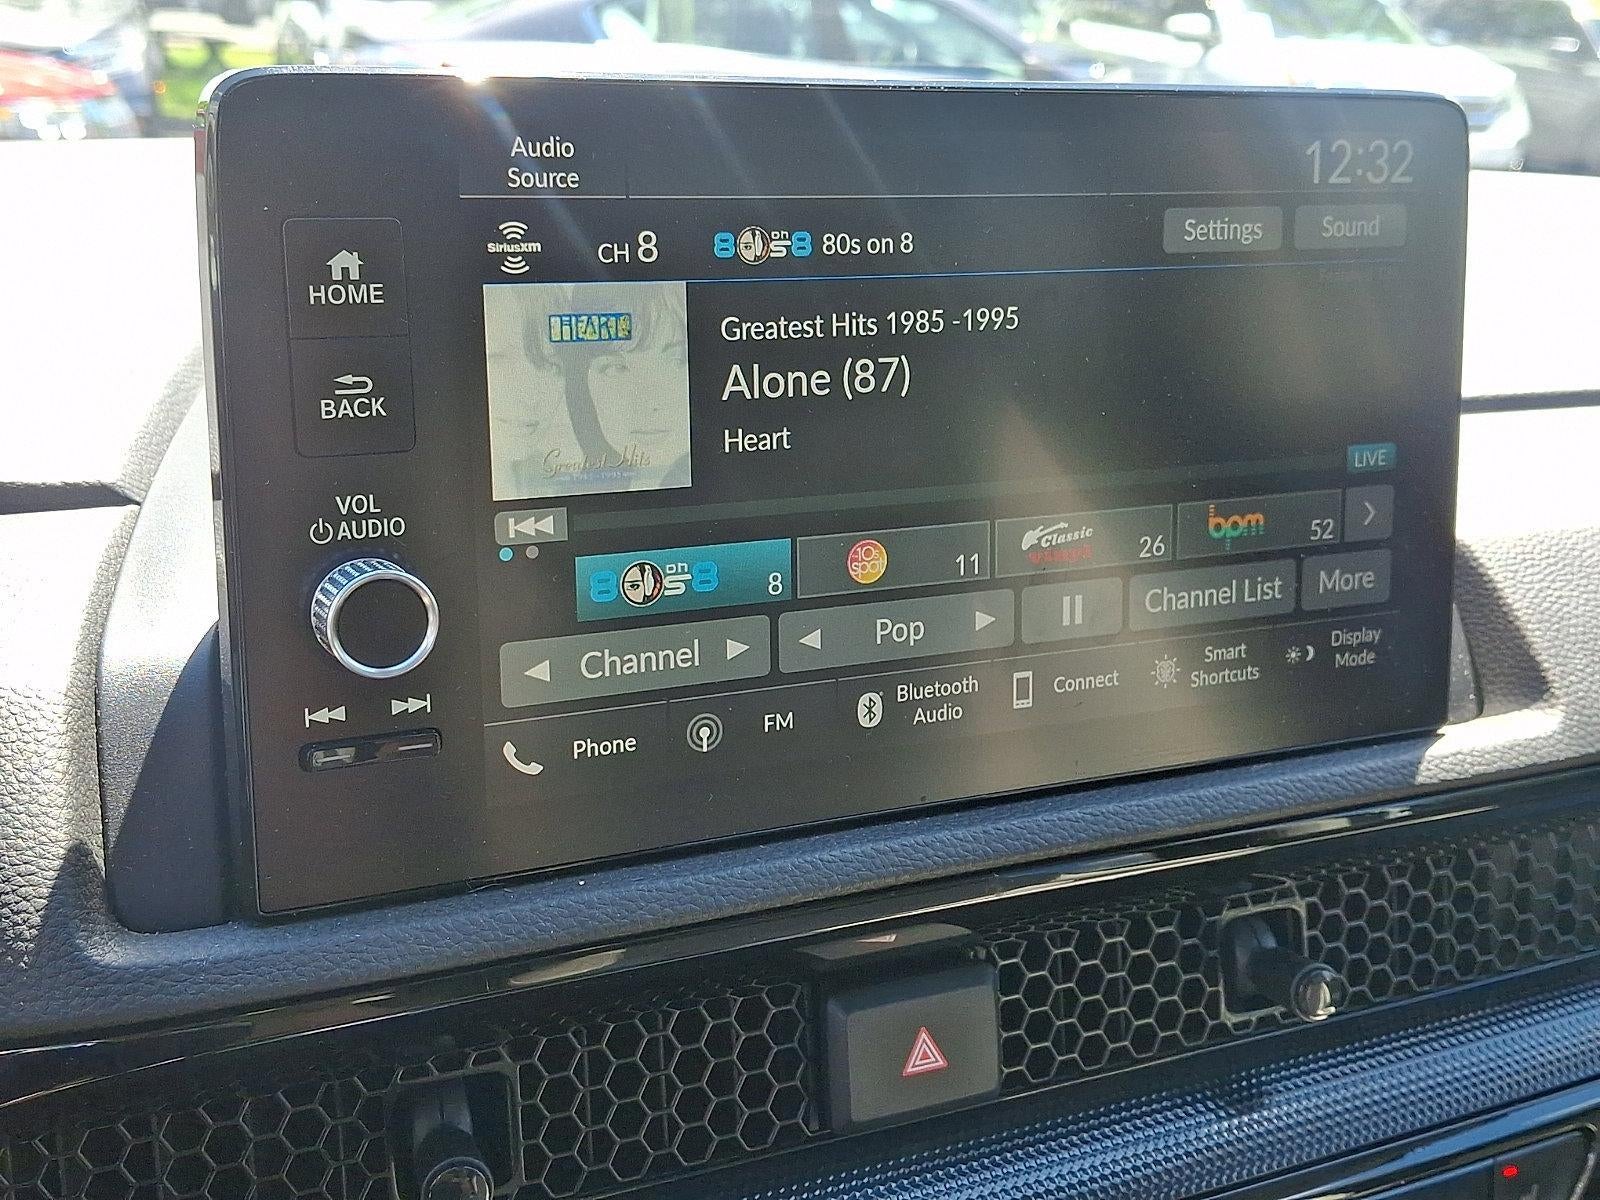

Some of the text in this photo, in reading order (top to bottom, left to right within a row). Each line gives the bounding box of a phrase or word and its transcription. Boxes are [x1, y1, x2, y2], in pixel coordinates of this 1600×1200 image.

[510, 136, 575, 159] Audio
[1306, 139, 1414, 185] 12:32
[507, 167, 580, 190] Source
[1184, 217, 1263, 244] Settings
[1321, 215, 1381, 238] Sound
[598, 230, 659, 264] CH 8
[822, 232, 914, 256] 80s on 8
[308, 284, 385, 306] HOME
[720, 306, 1020, 342] Greatest Hits 1985 -1995
[721, 355, 911, 401] Alone (87)
[320, 397, 387, 420] BACK
[724, 426, 791, 453] Heart
[1354, 449, 1387, 468] LIVE
[335, 495, 381, 515] VOL
[337, 517, 406, 541] AUDIO
[1041, 526, 1094, 548] Classic
[1310, 518, 1335, 541] 52
[1139, 535, 1166, 559] 26
[955, 553, 981, 577] 11
[768, 572, 784, 596] 8
[1318, 569, 1375, 595] More
[1145, 575, 1283, 614] Channel List
[875, 618, 926, 647] Pop
[1330, 626, 1382, 650] Display
[580, 639, 700, 679] Channel
[1204, 642, 1248, 662] Smart
[1334, 648, 1376, 669] Mode
[1053, 668, 1120, 694] Connect
[1190, 663, 1260, 688] Shortcuts
[896, 674, 980, 703] Bluetooth
[763, 711, 794, 733] FM
[912, 701, 964, 726] Audio
[572, 733, 637, 760] Phone
